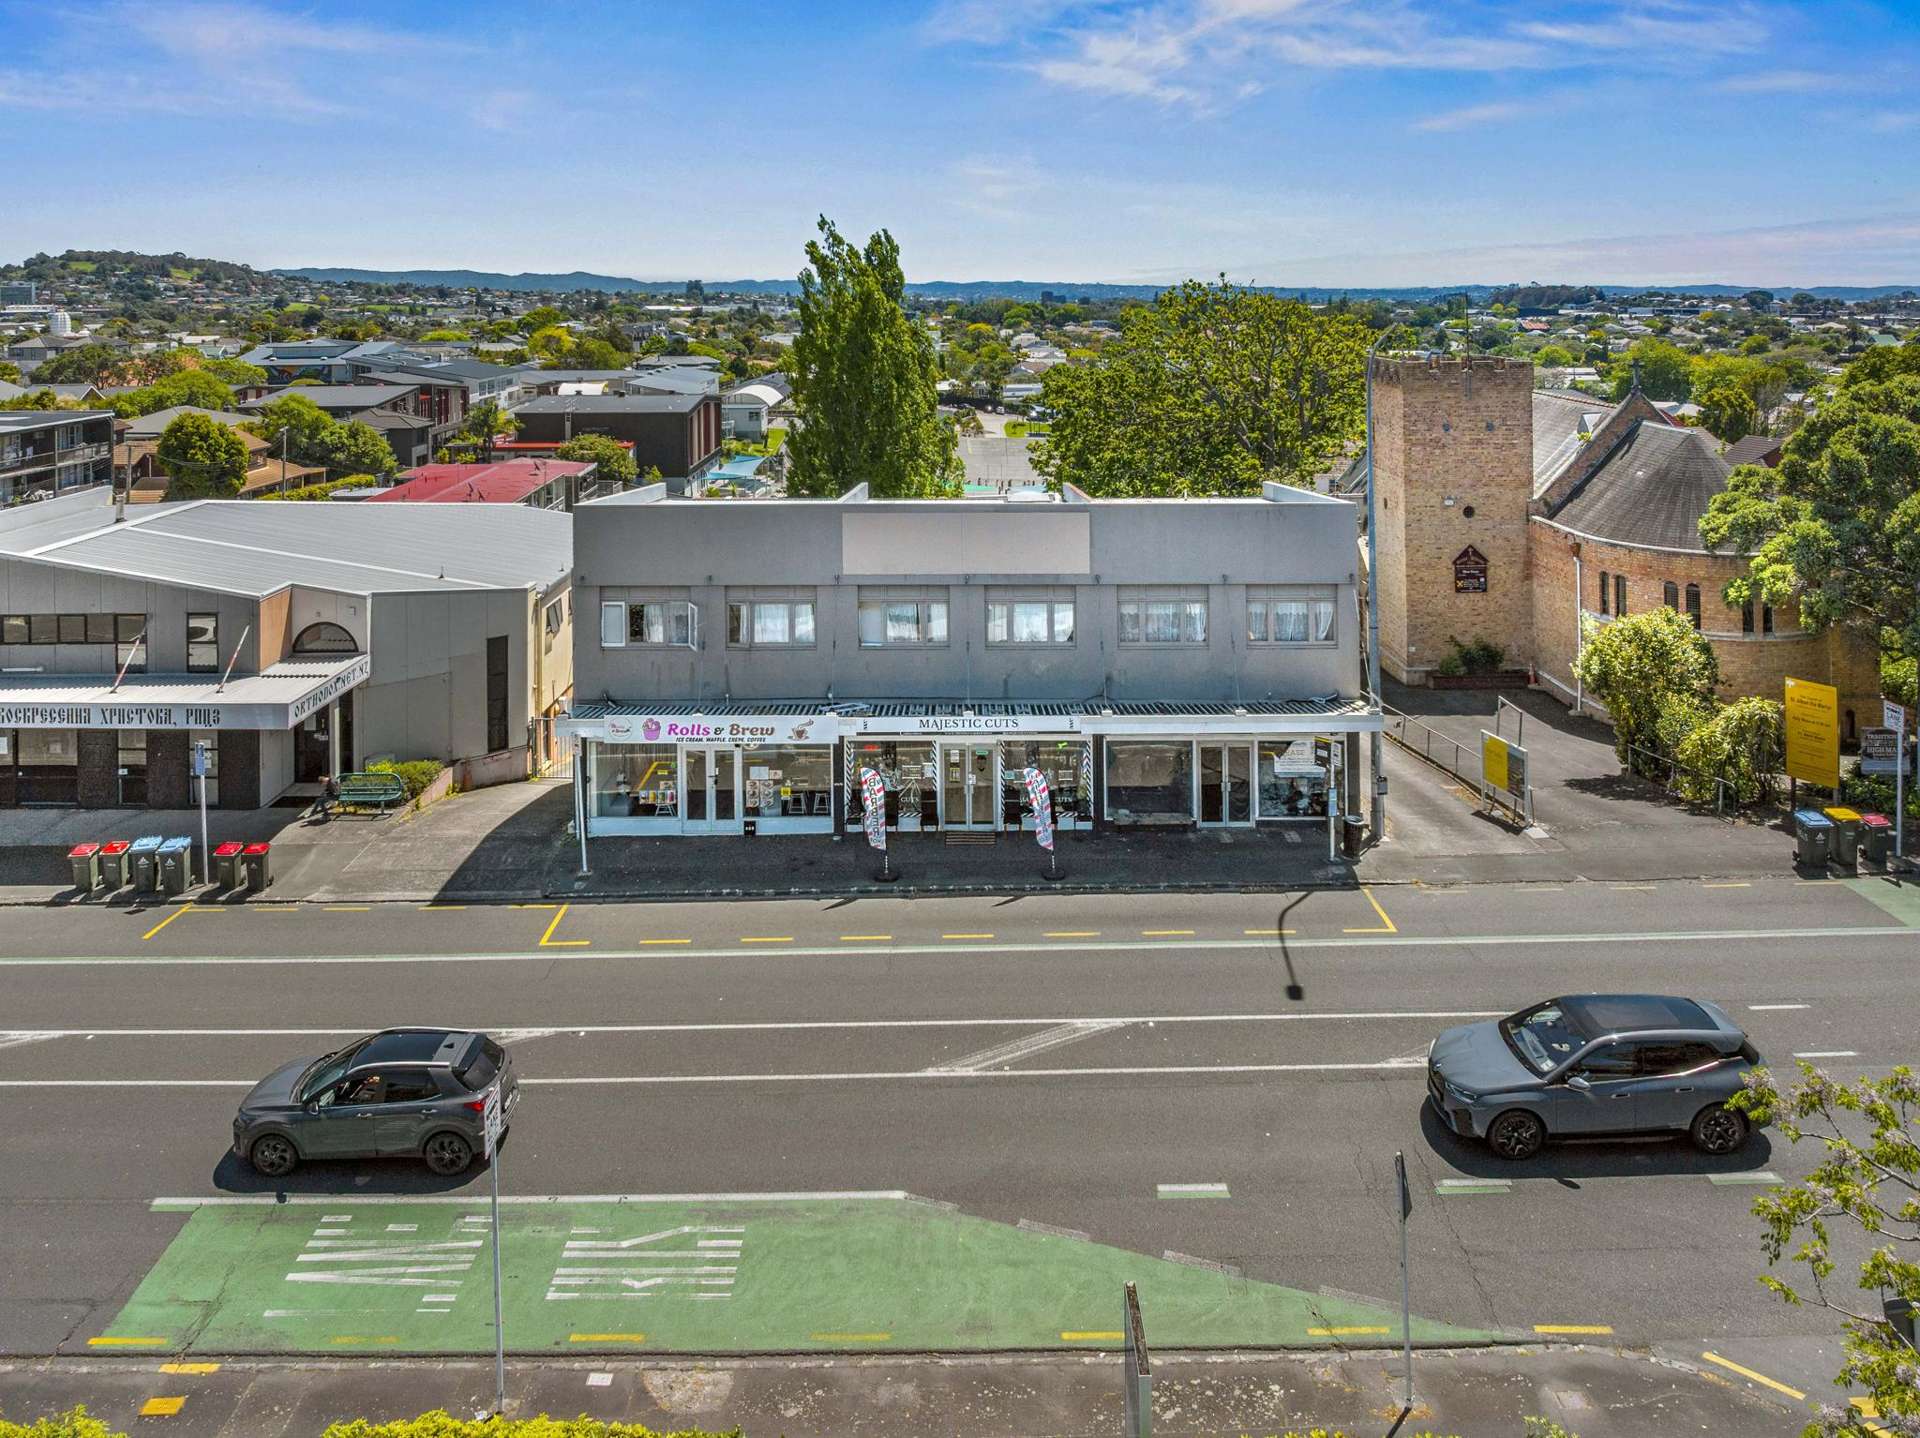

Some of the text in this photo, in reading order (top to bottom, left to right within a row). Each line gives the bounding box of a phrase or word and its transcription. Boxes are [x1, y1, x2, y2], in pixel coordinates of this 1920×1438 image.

[668, 723, 776, 736] Rolls & Brew
[919, 718, 1019, 730] MAJESTIC CUTS
